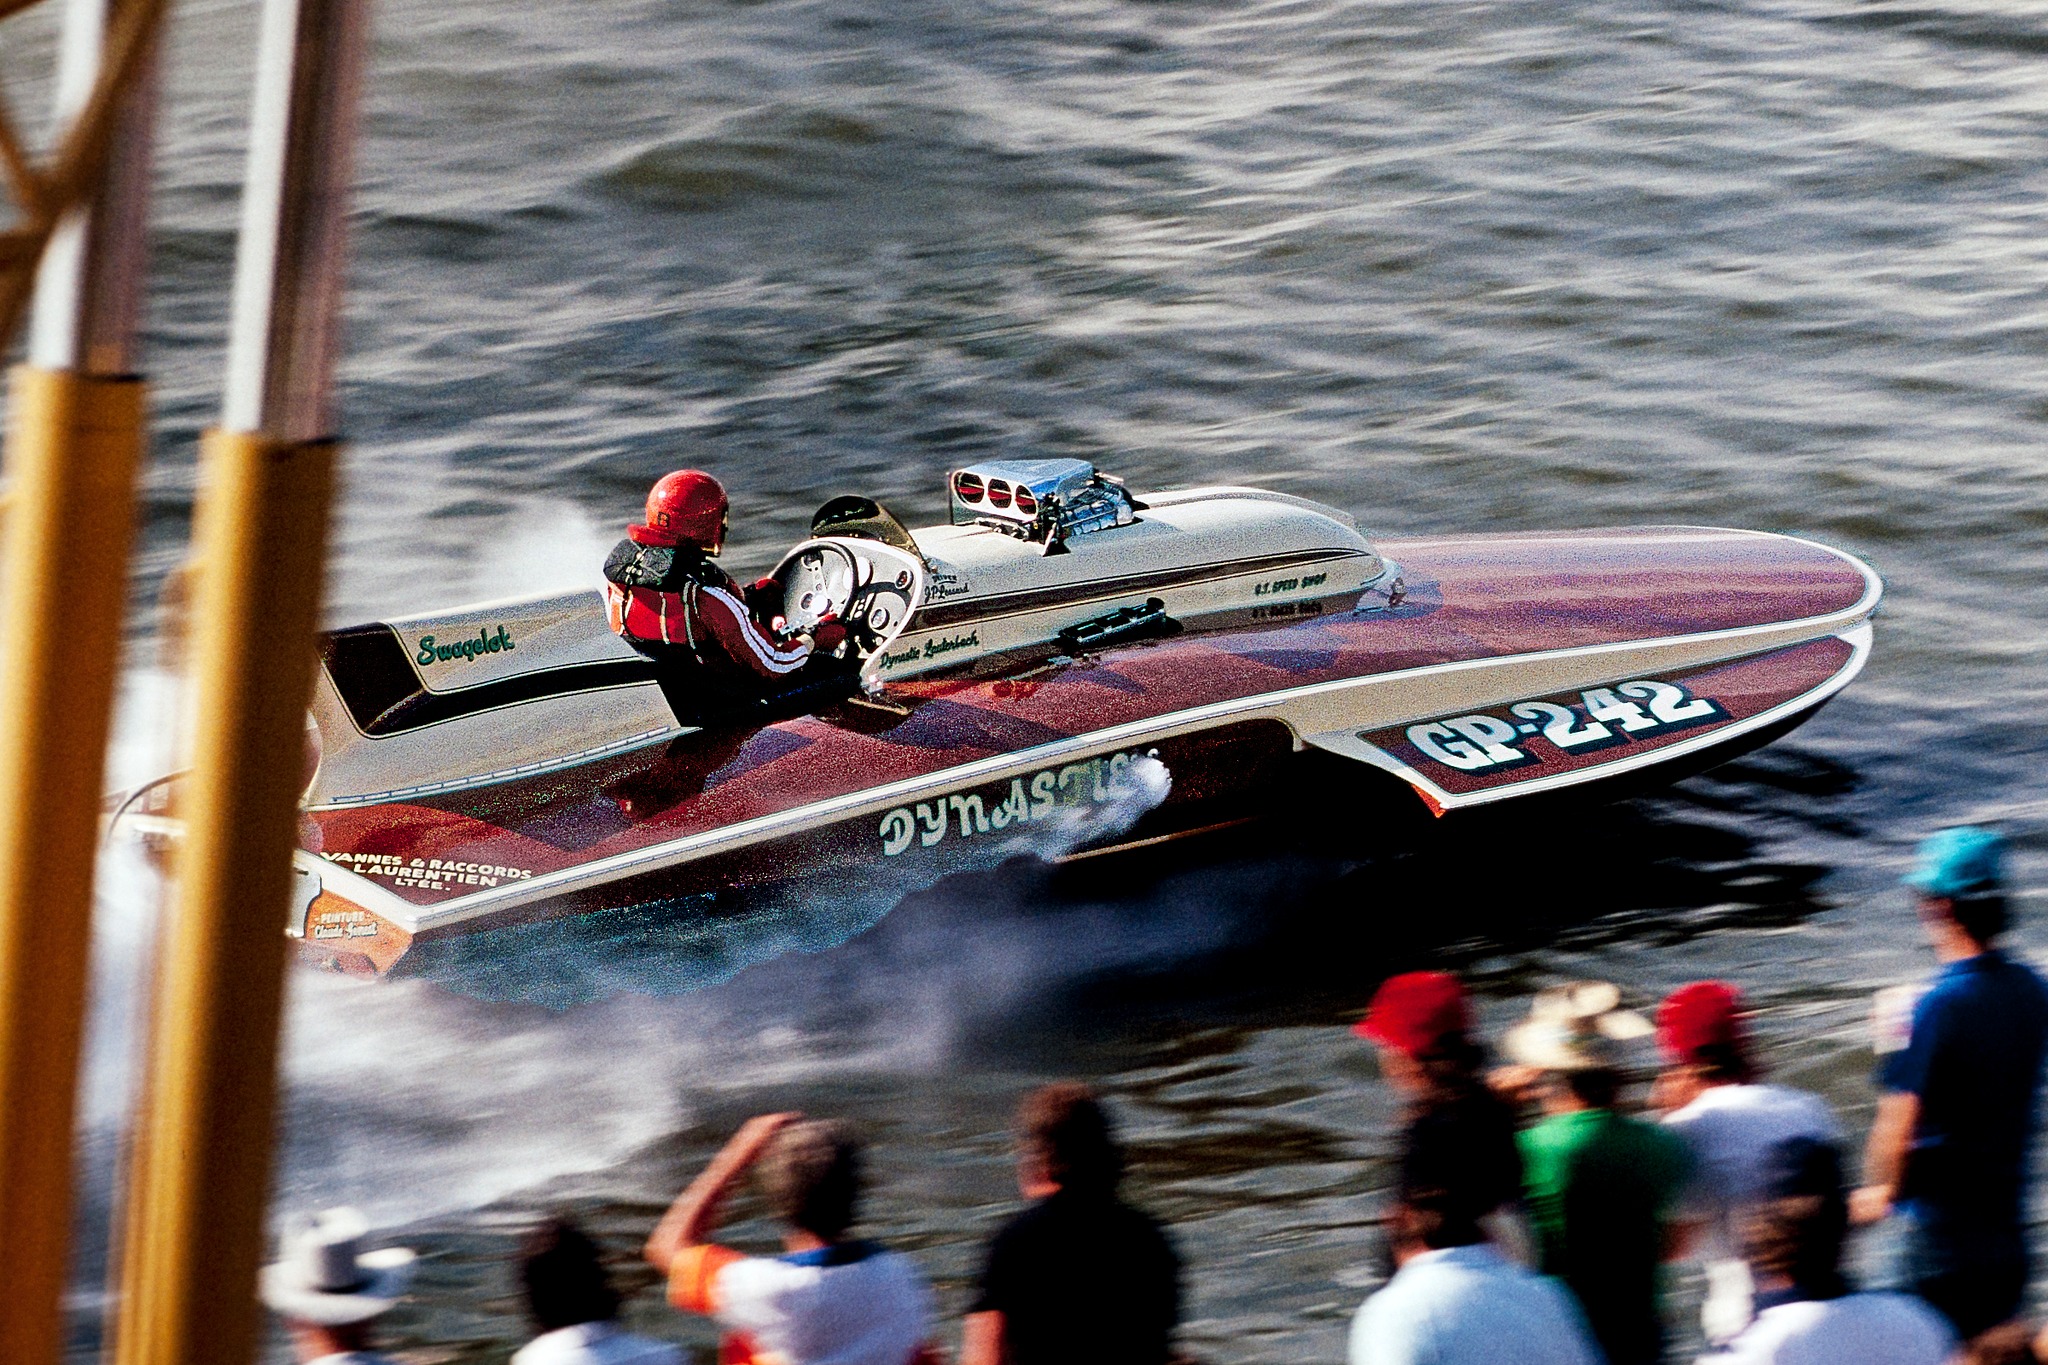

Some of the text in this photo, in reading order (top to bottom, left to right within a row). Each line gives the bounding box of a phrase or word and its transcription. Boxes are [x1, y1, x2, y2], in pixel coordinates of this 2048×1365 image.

[417, 624, 515, 666] Swagelok
[1405, 680, 1717, 770] GP-242
[319, 851, 532, 880] VANNES & RACCORDS
[353, 863, 499, 887] LAURENTIEN
